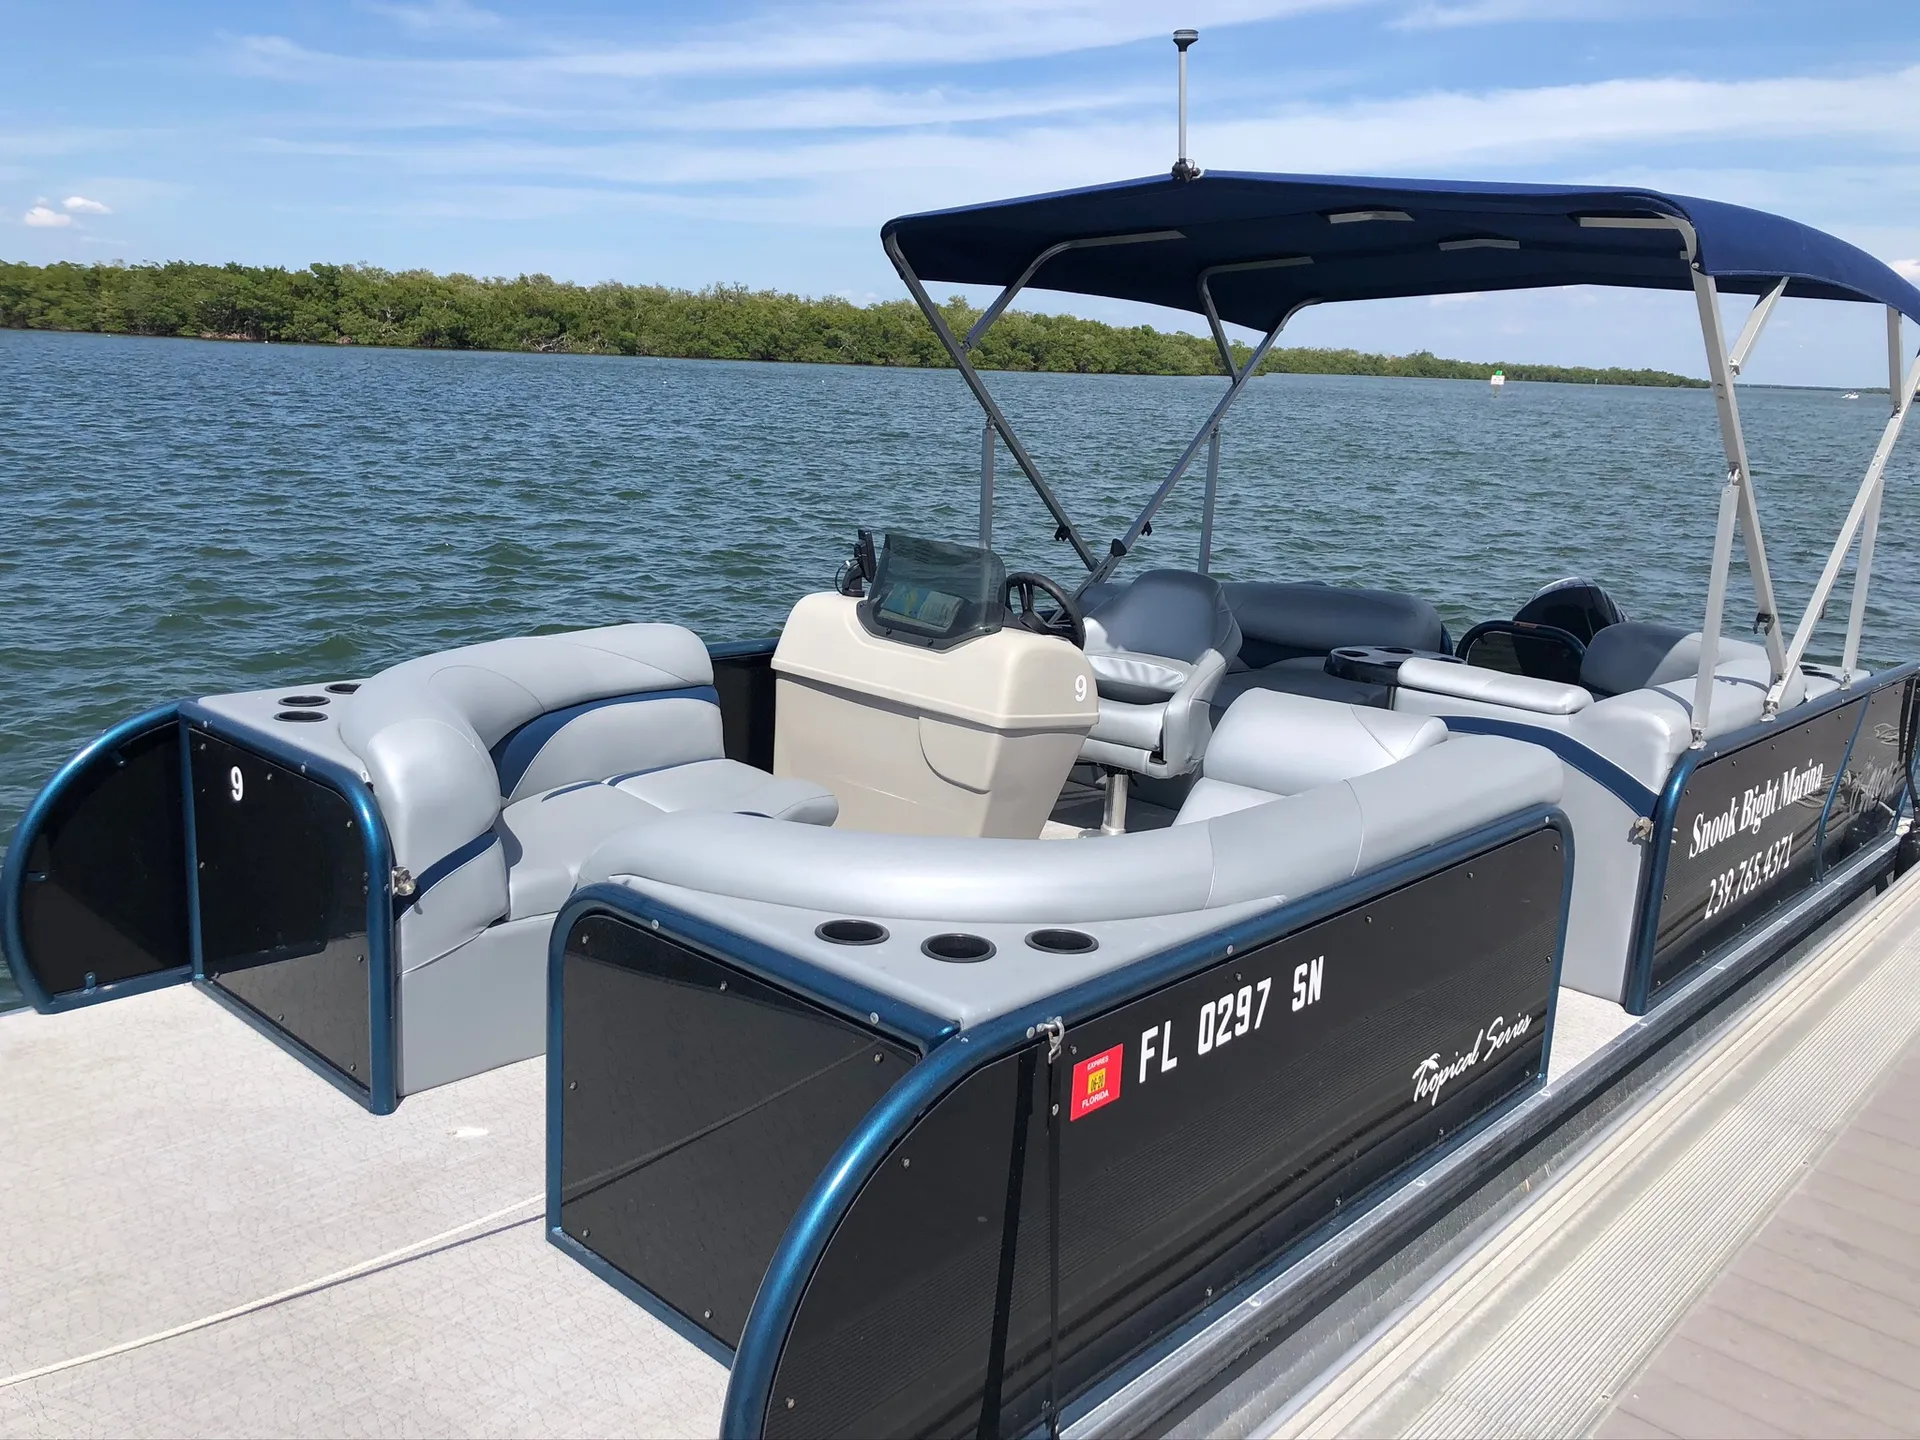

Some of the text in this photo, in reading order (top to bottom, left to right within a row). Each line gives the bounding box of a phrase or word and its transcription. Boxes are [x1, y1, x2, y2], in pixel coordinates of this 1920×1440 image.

[1074, 674, 1088, 702] 9
[230, 766, 243, 801] 9
[1688, 796, 1739, 859] Snook
[1739, 778, 1780, 835] Bight
[1780, 759, 1824, 806] Marina
[1704, 833, 1794, 920] 239.765.4371
[1139, 955, 1325, 1084] FL 0297 SN
[1087, 1055, 1109, 1071] EXPIRES
[1412, 1013, 1532, 1106] Tropical Series
[1081, 1089, 1109, 1109] FLORIDA
